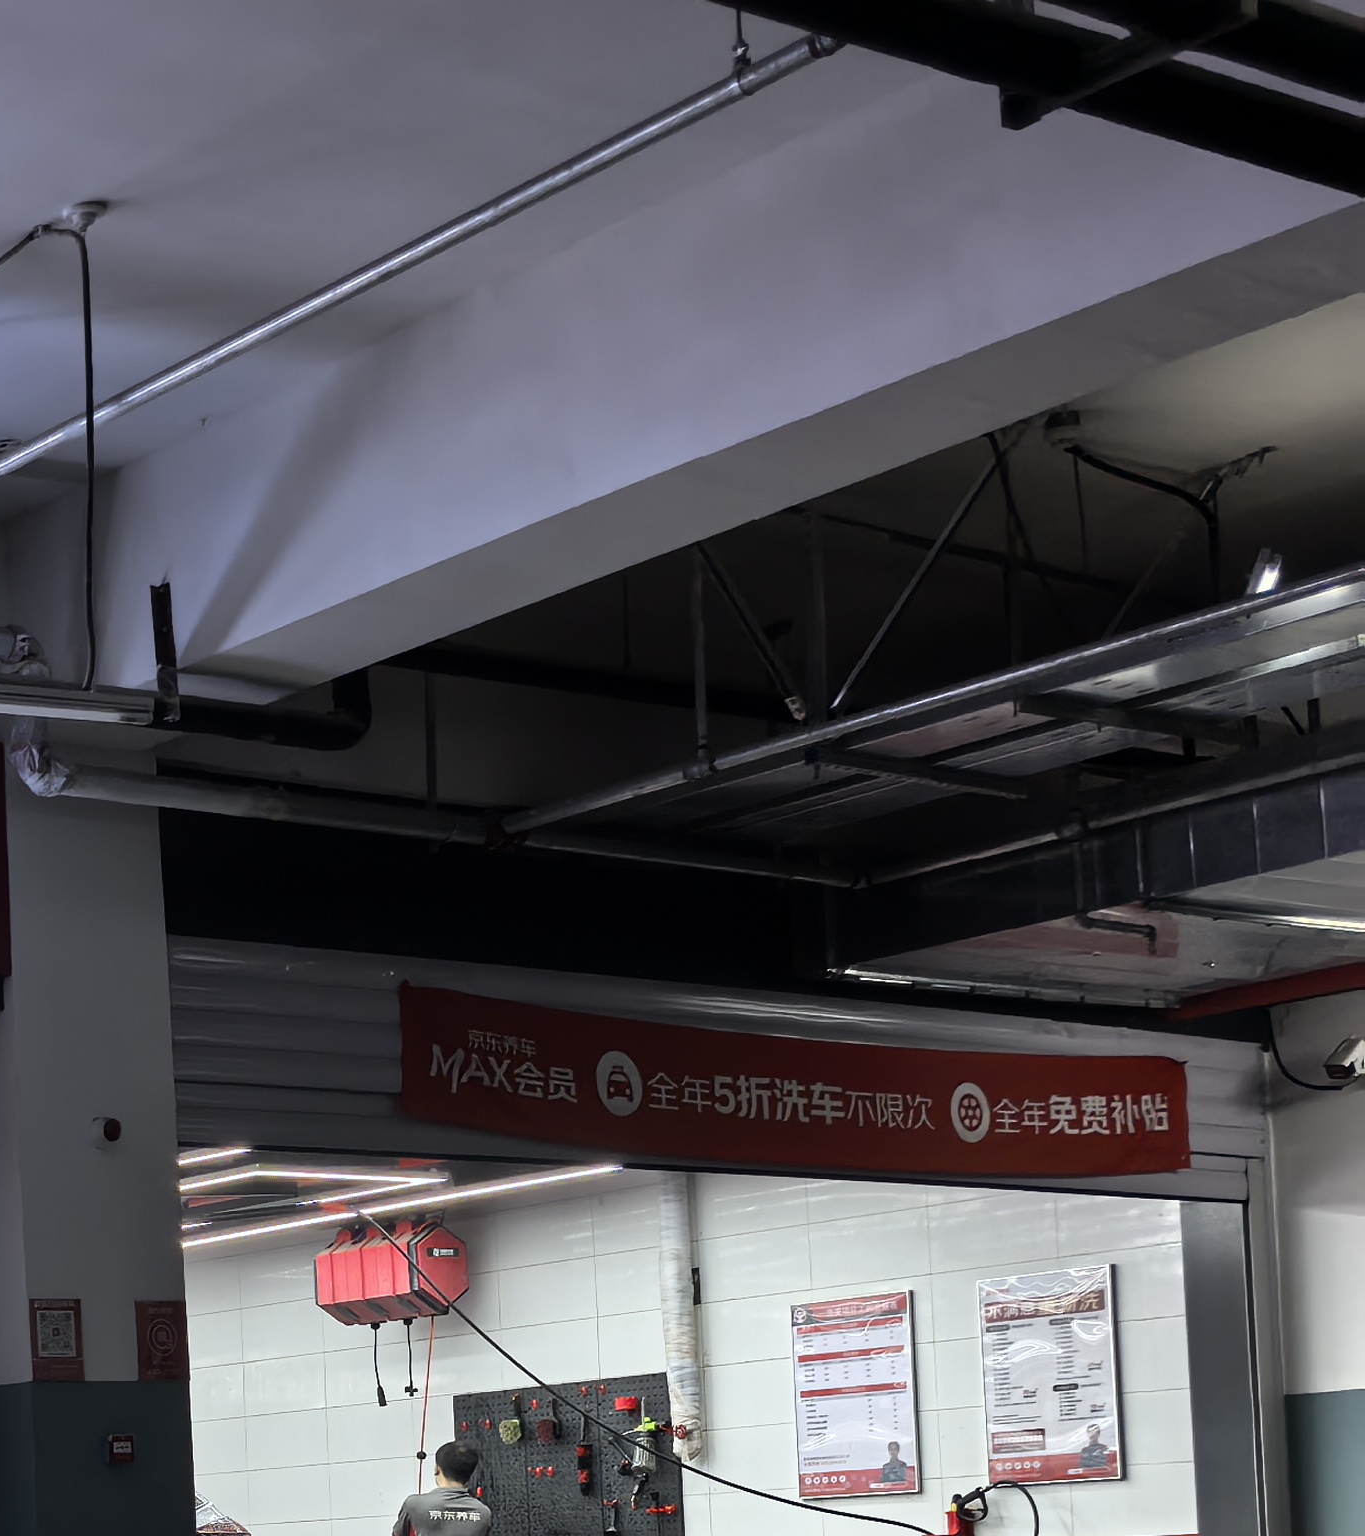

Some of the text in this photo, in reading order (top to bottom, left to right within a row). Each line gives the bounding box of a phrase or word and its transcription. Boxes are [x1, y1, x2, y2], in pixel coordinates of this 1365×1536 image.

[467, 1029, 537, 1058] 京东养车
[429, 1043, 1170, 1135] MAX会员 全年5折洗车不限次 全年免费补胎
